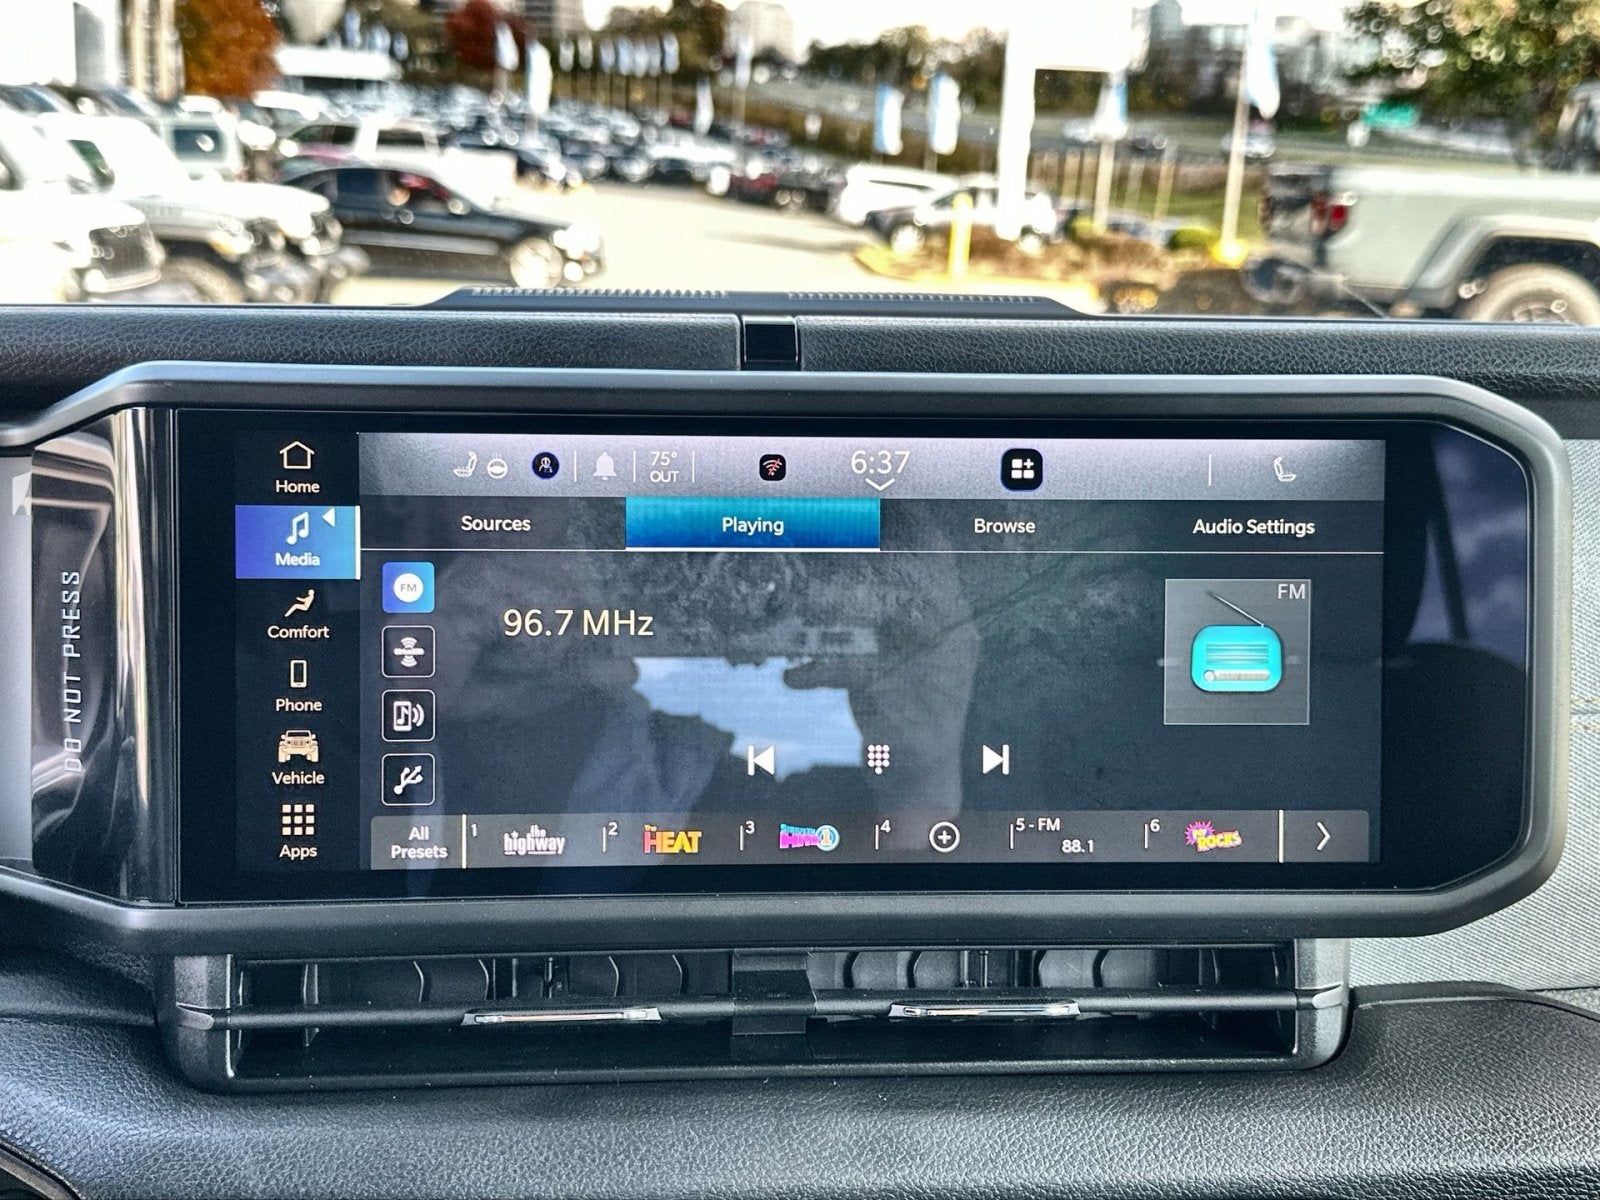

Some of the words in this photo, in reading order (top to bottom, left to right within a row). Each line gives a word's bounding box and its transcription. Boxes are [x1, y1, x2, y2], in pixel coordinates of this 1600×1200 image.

[650, 451, 678, 467] 75°
[850, 450, 911, 475] 6:37
[649, 468, 679, 483] OUT
[275, 479, 320, 494] Home
[460, 515, 531, 532] Sources
[721, 516, 785, 536] Playing
[973, 517, 1036, 534] Browse
[1193, 517, 1241, 535] Audio
[1246, 517, 1316, 538] Settings
[275, 551, 321, 567] Media
[400, 583, 417, 593] FM
[1277, 583, 1306, 600] FM
[61, 571, 82, 658] PRESS
[503, 608, 573, 637] 96.7
[583, 609, 654, 637] MHz
[267, 624, 330, 639] Comfort
[63, 671, 82, 723] NOT
[275, 697, 323, 712] Phone
[64, 737, 82, 773] DO
[271, 770, 325, 785] Vehicle
[470, 823, 478, 837] 1
[530, 824, 546, 837] the
[608, 821, 618, 836] 2
[745, 820, 755, 835] 3
[880, 819, 891, 833] 4
[1015, 817, 1026, 831] 5
[1037, 817, 1061, 831] FM
[1149, 818, 1161, 832] 6
[408, 825, 430, 841] All
[1197, 831, 1242, 851] ROCKS
[503, 831, 566, 855] highway
[644, 831, 702, 853] HEAT
[1061, 839, 1094, 853] 88.1
[279, 844, 318, 861] Apps
[390, 844, 448, 860] Presets
